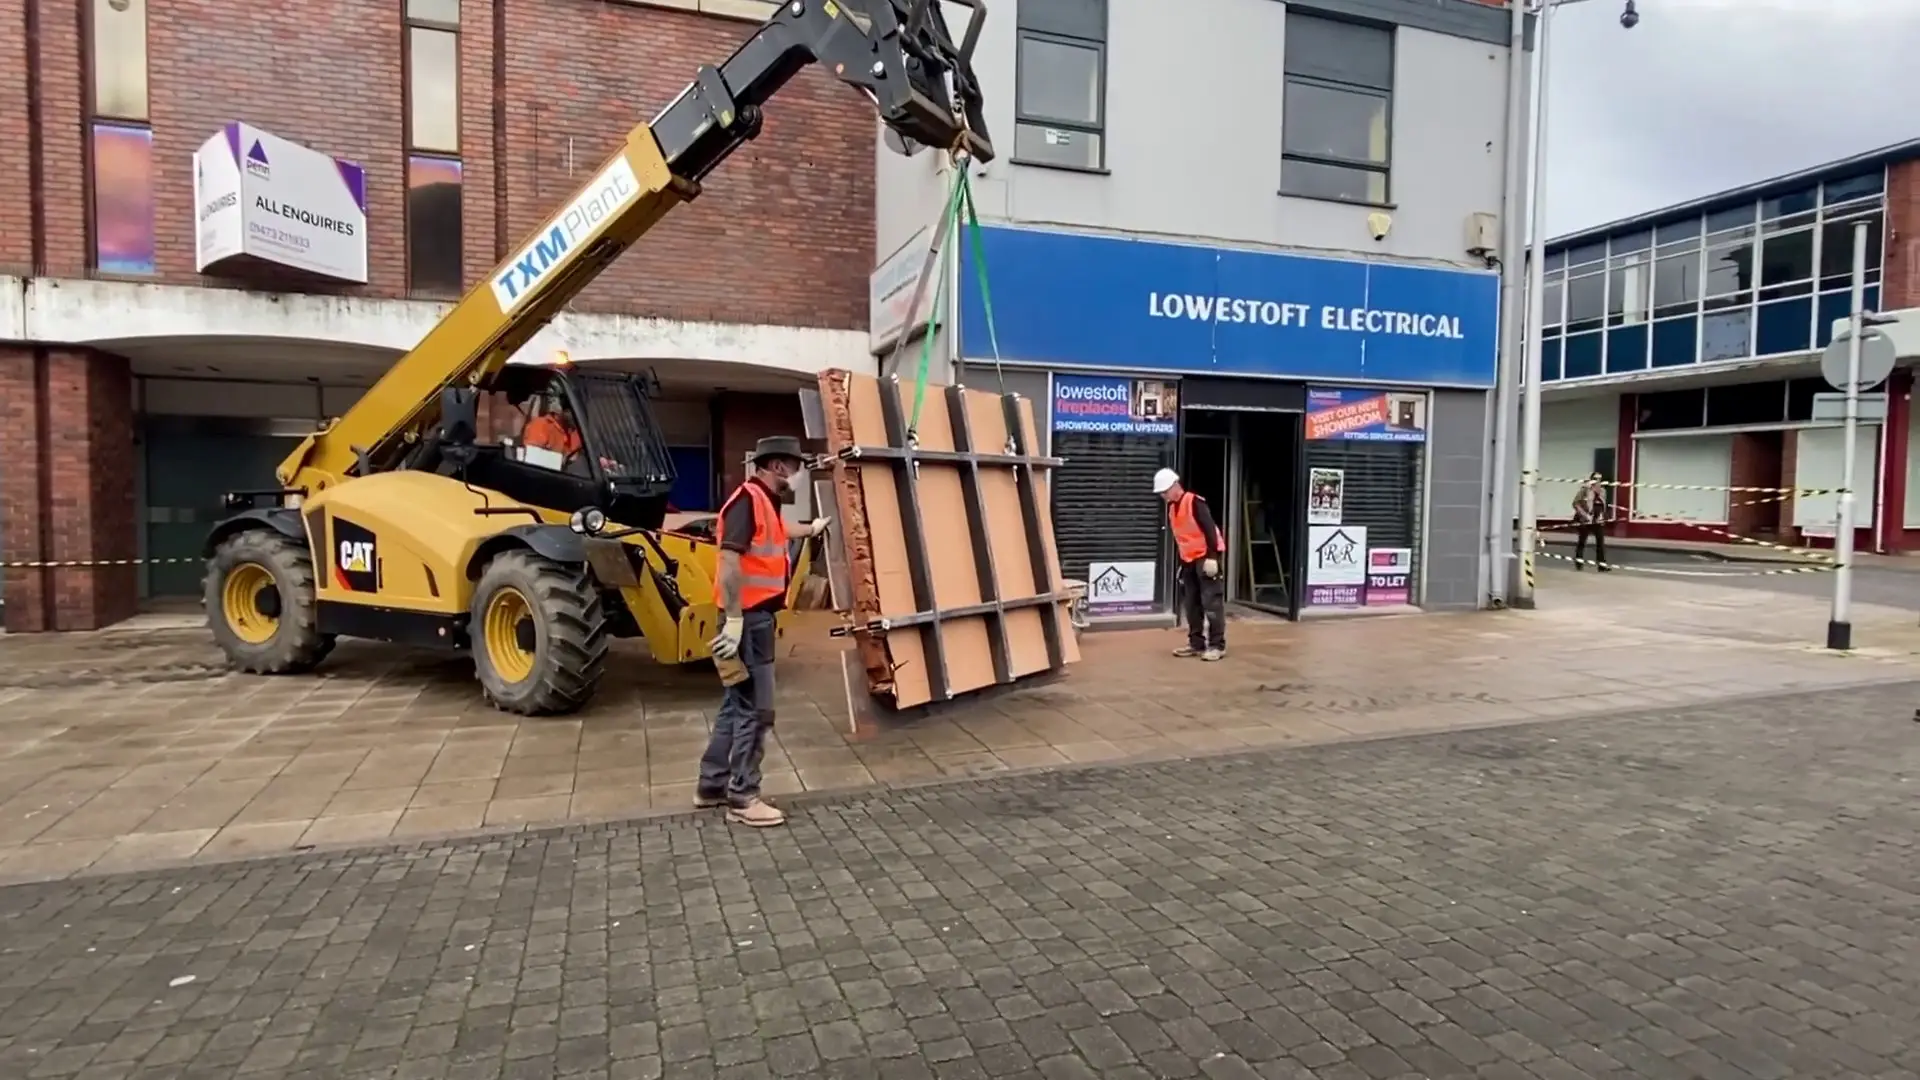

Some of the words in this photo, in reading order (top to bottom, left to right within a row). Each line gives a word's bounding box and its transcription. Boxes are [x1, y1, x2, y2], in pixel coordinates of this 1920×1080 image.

[255, 196, 280, 216] ALL
[282, 204, 355, 237] ENQUIRIES
[499, 226, 568, 299] TXM
[564, 176, 630, 243] Plant
[1149, 291, 1311, 328] LOWESTOFT
[1321, 305, 1465, 339] ELECTRICAL
[1056, 382, 1128, 401] lowestoft
[1056, 400, 1129, 416] fireplaces
[1335, 405, 1357, 419] OUR
[1055, 420, 1109, 431] SHOWROOM
[1110, 422, 1134, 432] OPEN
[1135, 423, 1175, 433] UPSTAIRS
[1313, 410, 1382, 437] SHOWROOM
[340, 540, 374, 573] CAT
[1370, 576, 1386, 587] TO
[1386, 576, 1406, 588] LET
